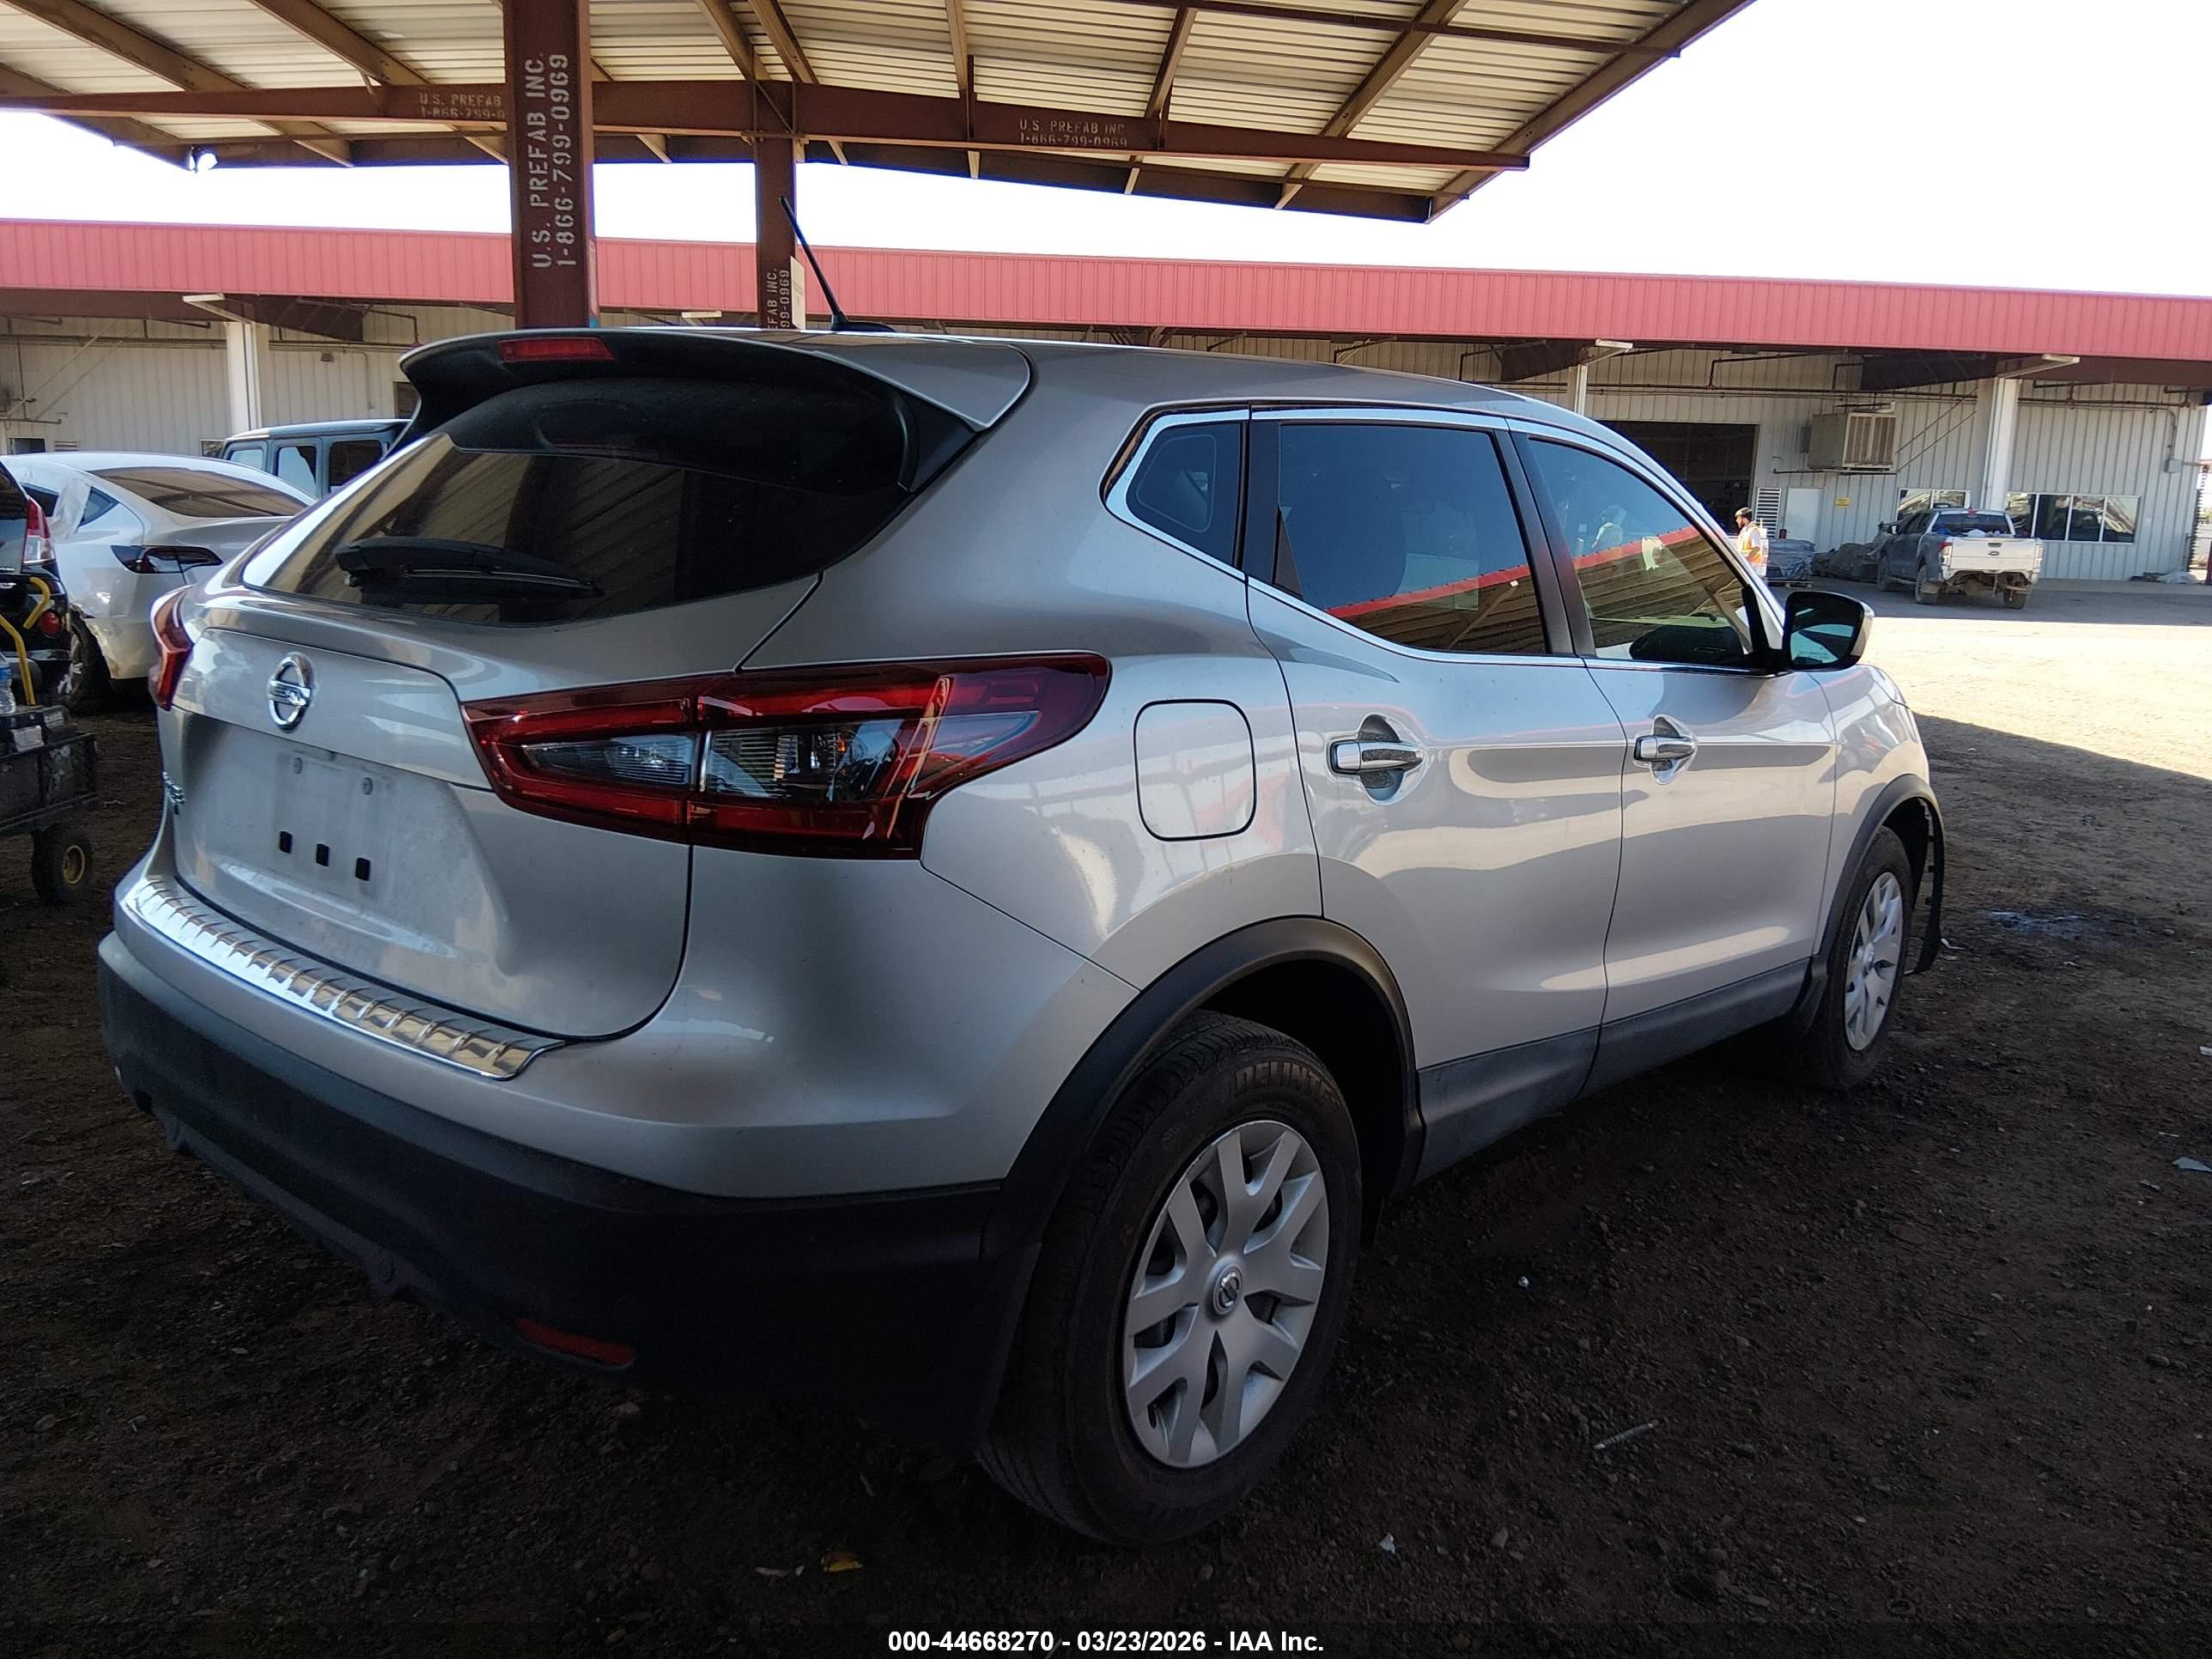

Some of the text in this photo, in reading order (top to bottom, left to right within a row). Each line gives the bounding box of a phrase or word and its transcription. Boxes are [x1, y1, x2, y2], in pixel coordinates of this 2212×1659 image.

[451, 94, 502, 107] PREFAB
[1049, 119, 1099, 134] PREFAB
[524, 52, 552, 268] U.S. PREFAB INC.
[549, 54, 577, 266] 1-866-799-0969
